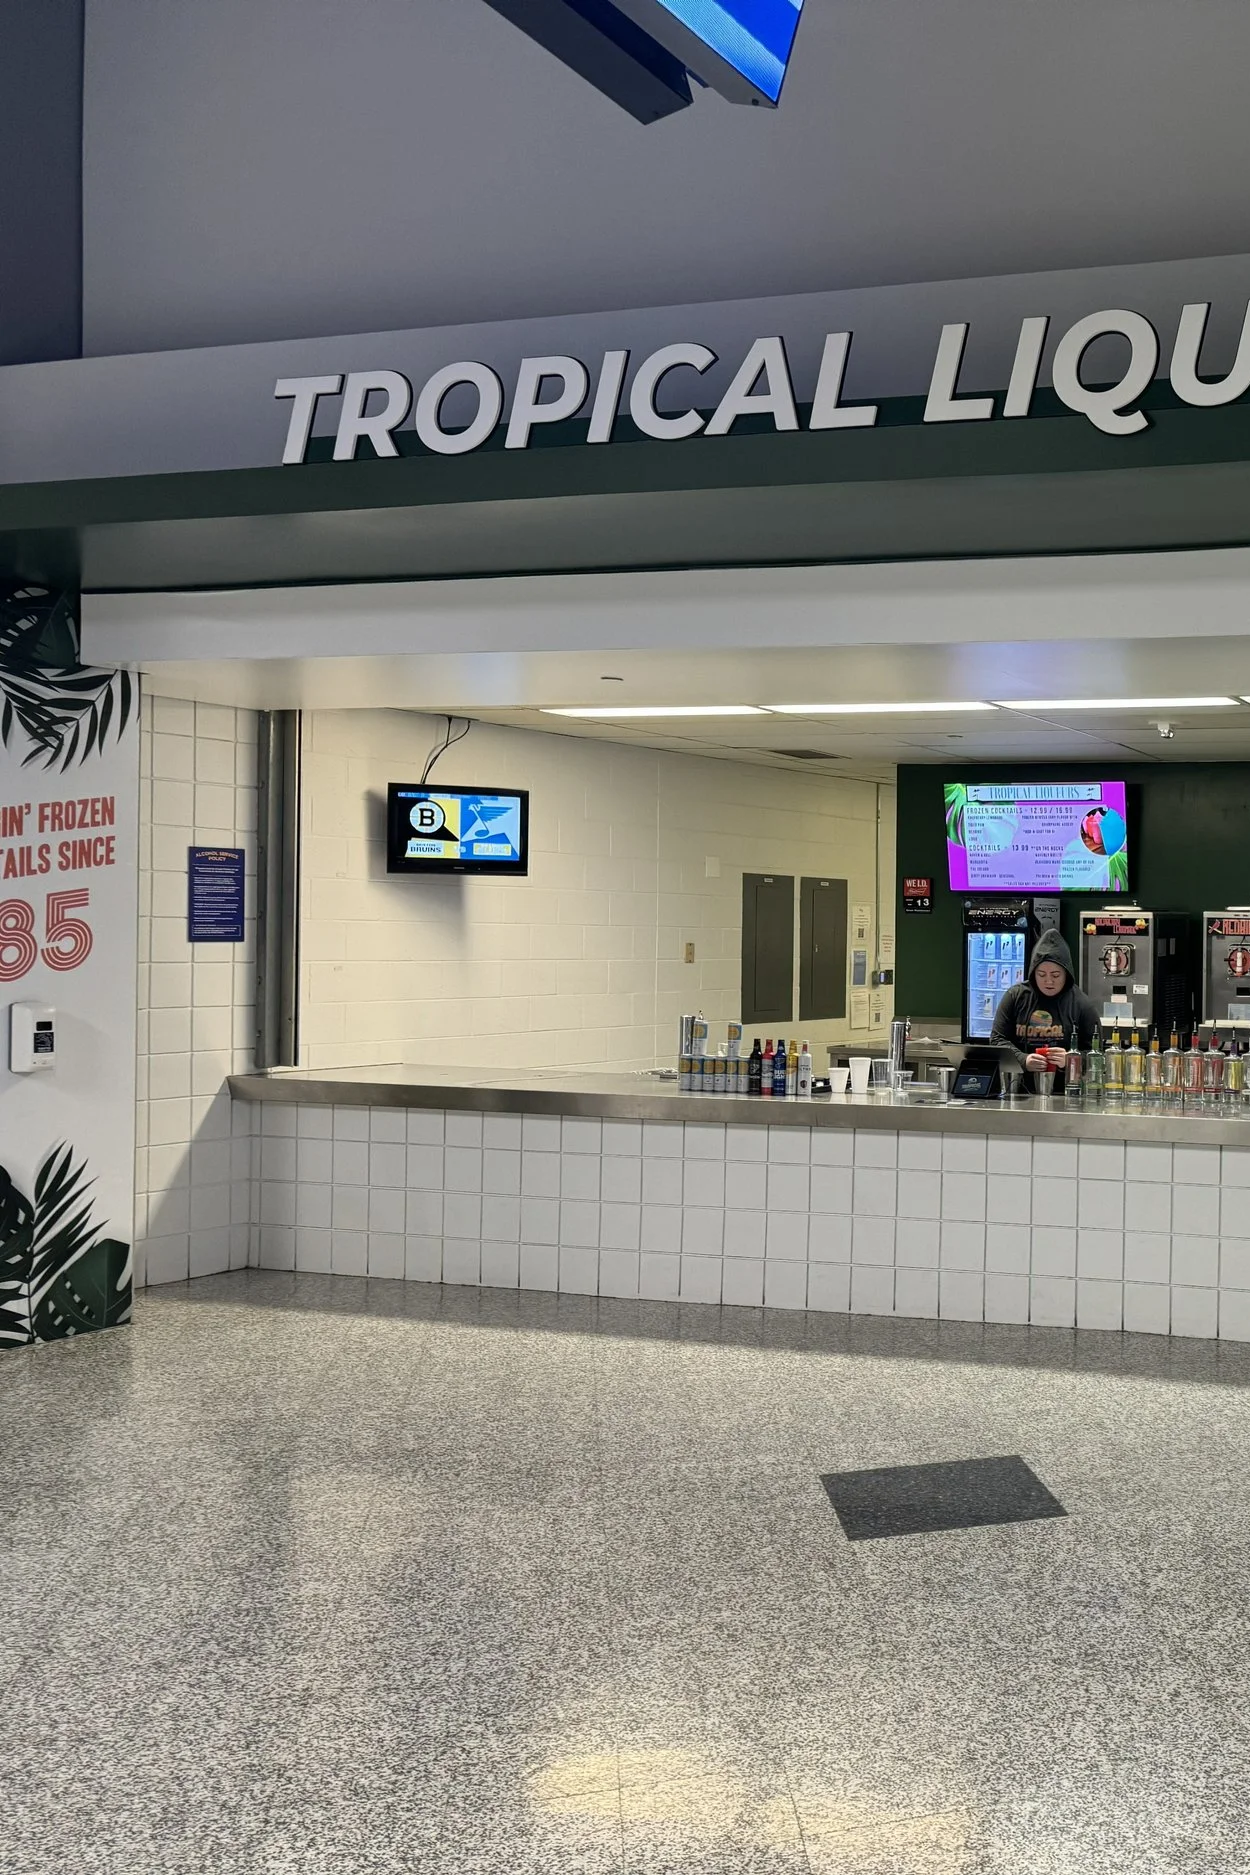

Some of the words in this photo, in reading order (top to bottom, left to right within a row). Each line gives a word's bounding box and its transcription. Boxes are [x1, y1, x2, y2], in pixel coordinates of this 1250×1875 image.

[274, 332, 880, 467] TROPICAL
[989, 787, 1031, 800] TROPICAL
[1035, 786, 1080, 800] LIQUEURS
[0, 802, 31, 838] IN’
[38, 796, 115, 833] FROZEN
[418, 808, 435, 826] B
[58, 836, 116, 872] SINCE
[969, 844, 1001, 852] COCKTAILS
[906, 879, 916, 887] WE
